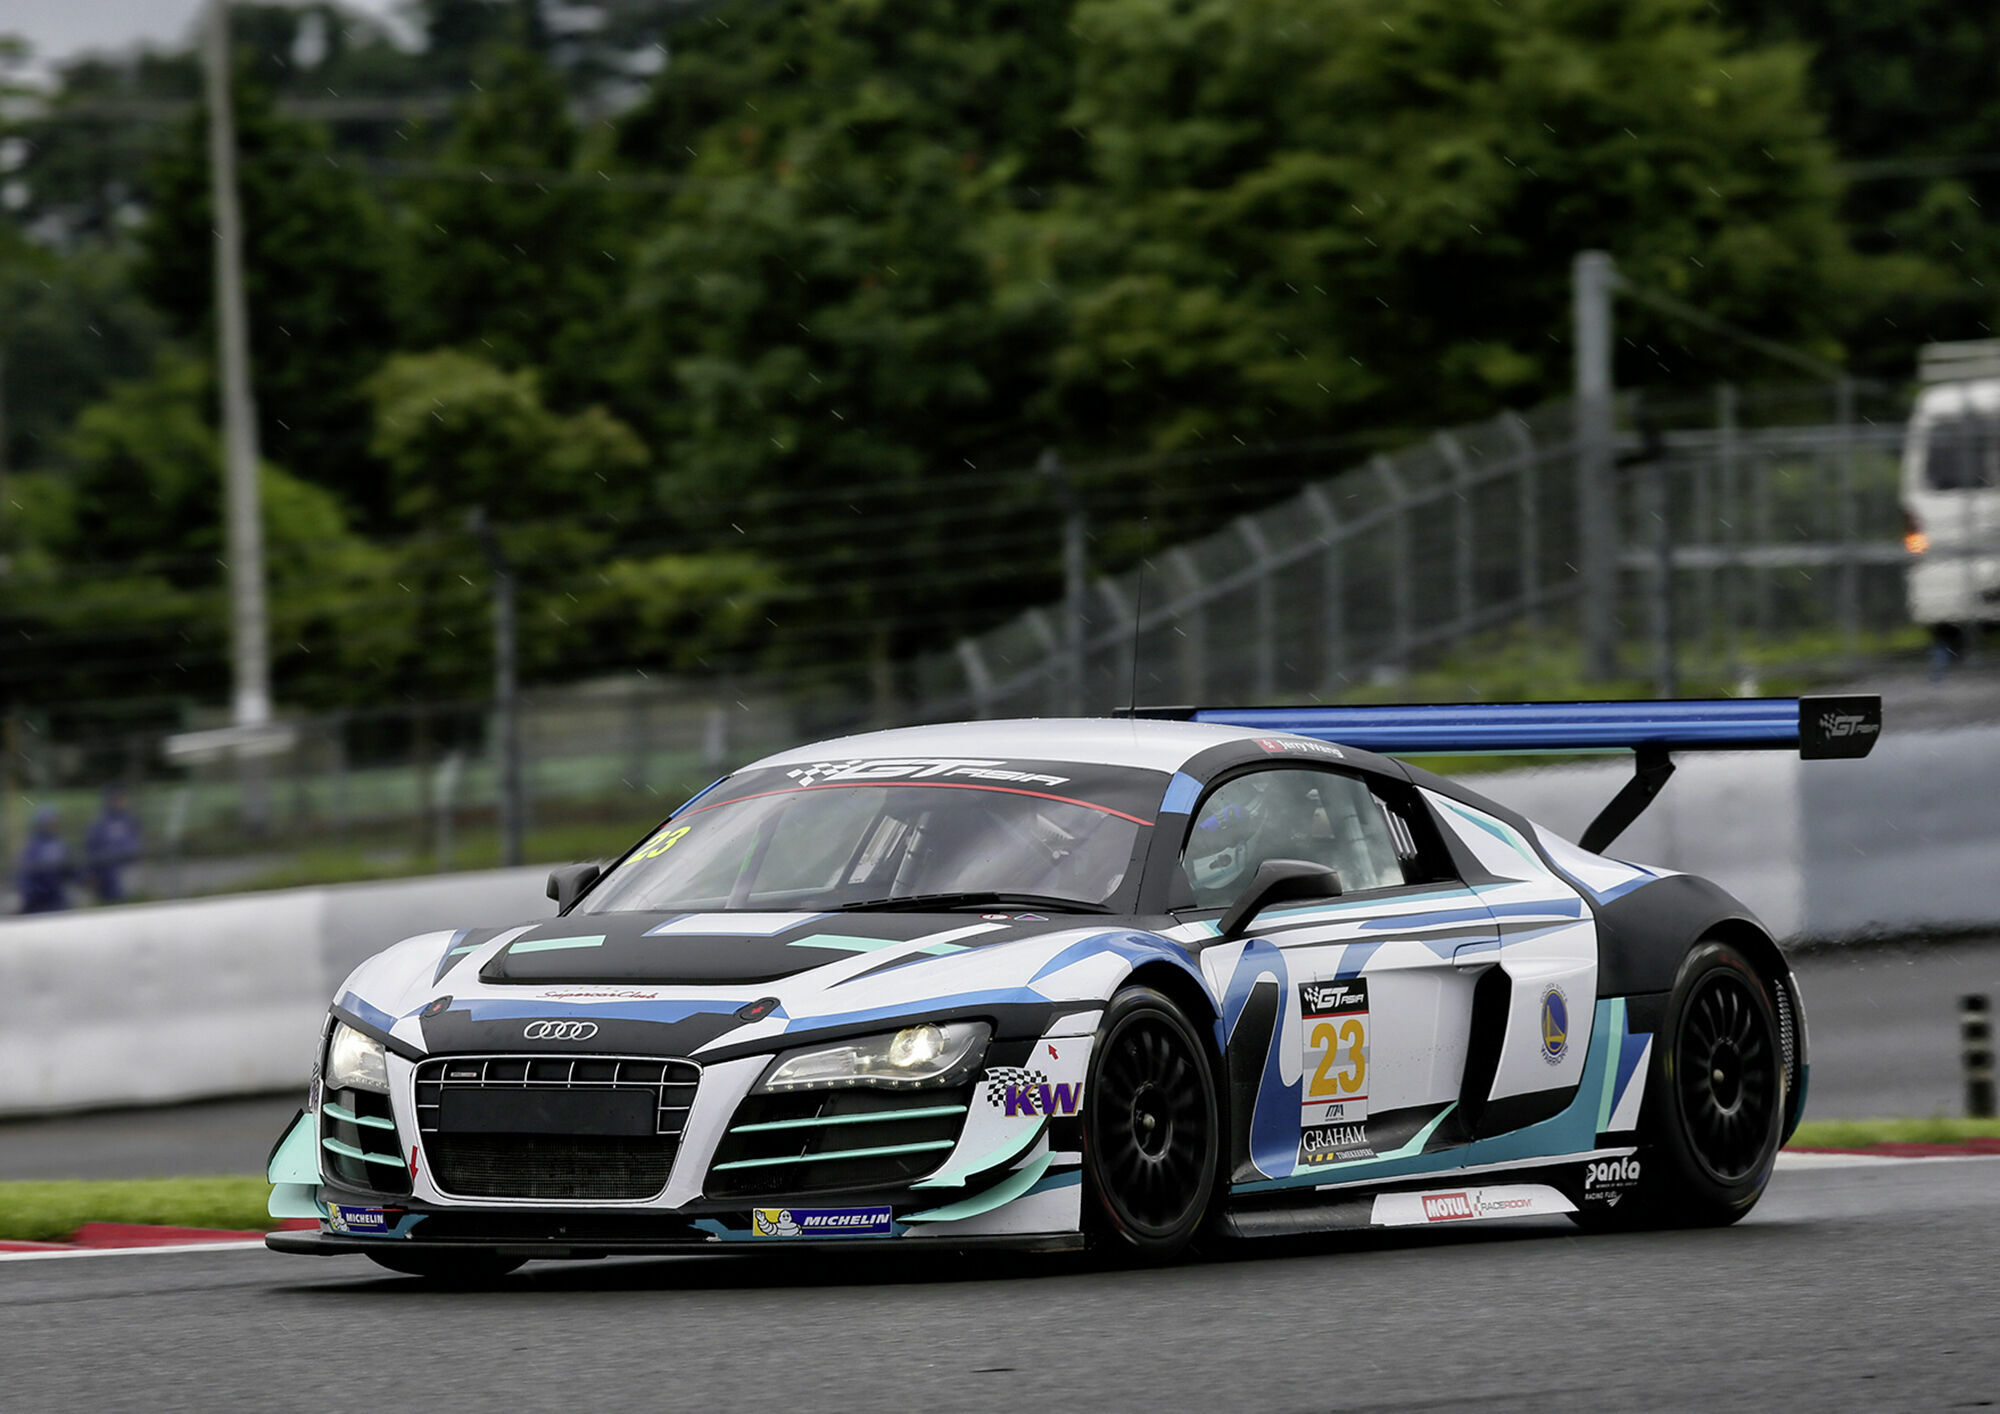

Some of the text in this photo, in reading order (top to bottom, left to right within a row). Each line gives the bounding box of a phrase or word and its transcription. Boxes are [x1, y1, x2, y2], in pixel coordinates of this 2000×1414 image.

[822, 758, 1008, 782] GT
[622, 826, 692, 867] 23
[1316, 986, 1349, 1009] GT
[1310, 1019, 1366, 1098] 23
[1005, 1082, 1083, 1117] KW
[1303, 1126, 1367, 1152] GRAHAM
[1585, 1156, 1641, 1190] panta
[1426, 1196, 1471, 1218] MOTUL
[1480, 1199, 1533, 1211] RACEROOM
[345, 1213, 384, 1224] MICHELIN
[803, 1213, 890, 1226] MICHELIN
